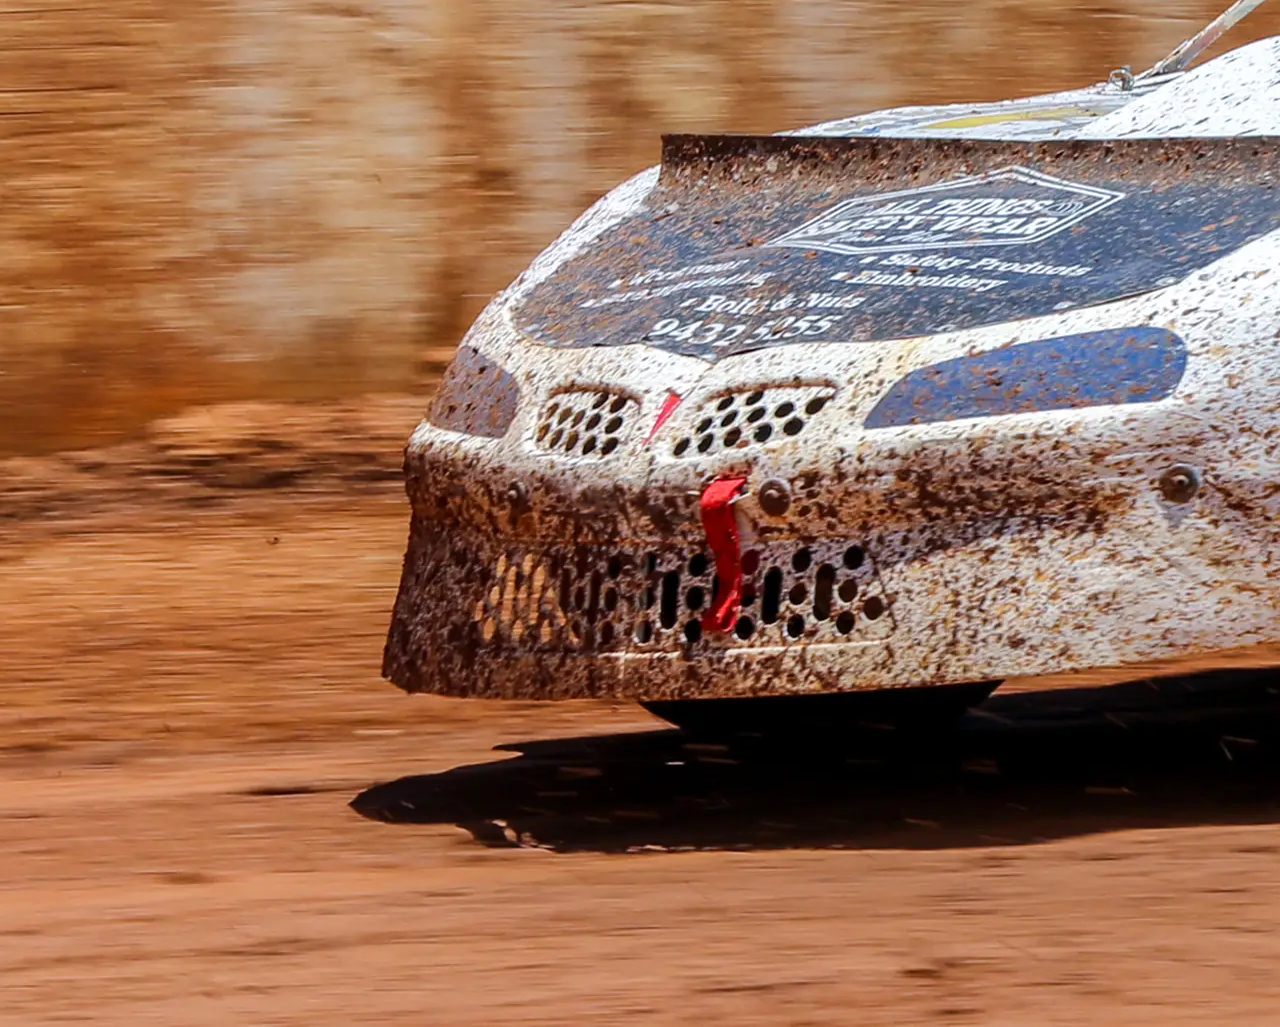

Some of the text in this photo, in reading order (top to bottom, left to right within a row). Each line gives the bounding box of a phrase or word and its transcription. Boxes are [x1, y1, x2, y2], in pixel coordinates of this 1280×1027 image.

[866, 198, 1050, 216] ALL THINGS
[930, 216, 1057, 235] WEAR
[879, 253, 1092, 277] Safety Products
[847, 272, 1008, 292] Embroidery
[801, 293, 866, 309] Nuts
[649, 318, 746, 347] 9432
